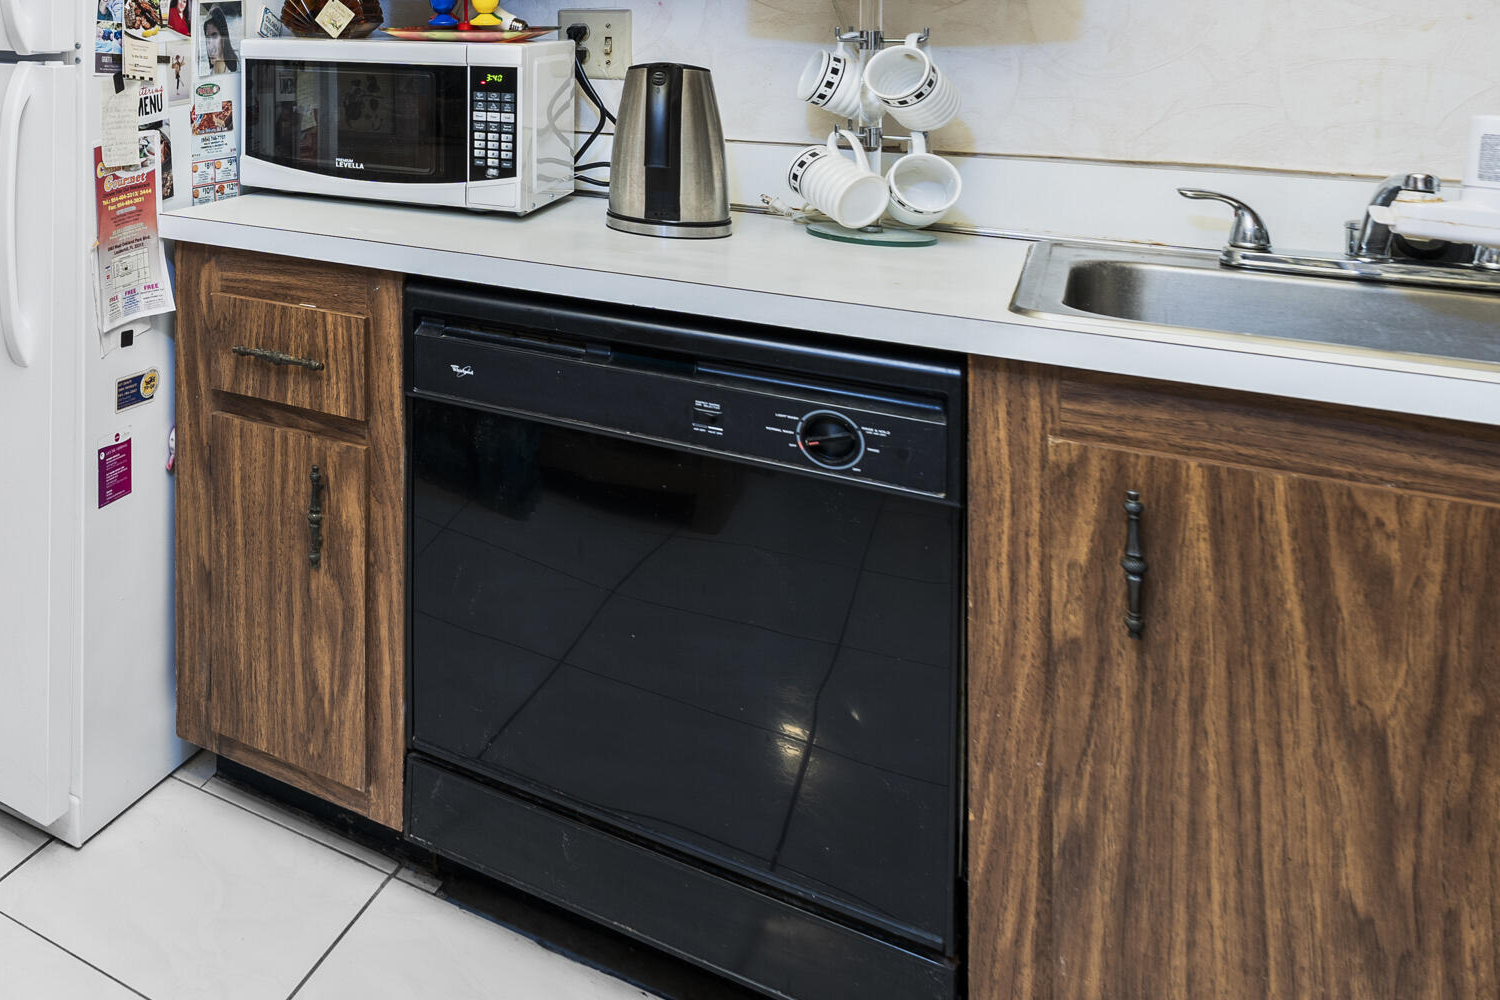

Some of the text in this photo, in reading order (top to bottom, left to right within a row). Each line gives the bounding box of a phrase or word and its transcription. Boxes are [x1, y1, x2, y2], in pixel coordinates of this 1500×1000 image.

[336, 161, 364, 170] LEVELLA
[104, 172, 147, 193] Gourmet
[143, 282, 160, 291] FREE
[124, 287, 137, 296] FREE
